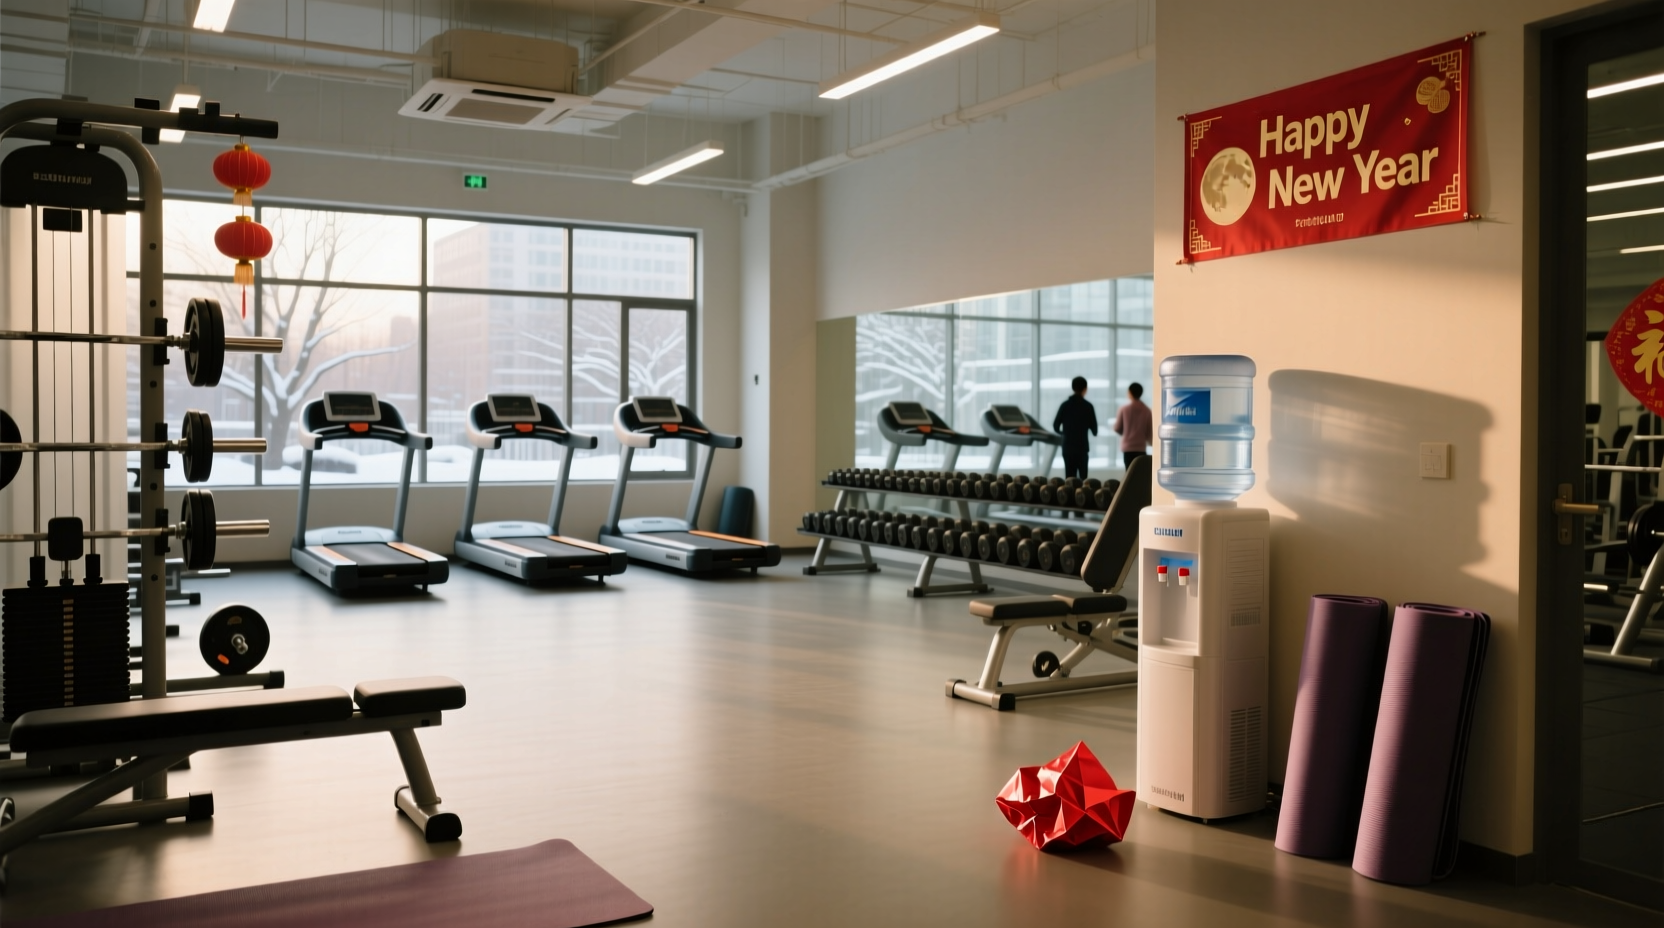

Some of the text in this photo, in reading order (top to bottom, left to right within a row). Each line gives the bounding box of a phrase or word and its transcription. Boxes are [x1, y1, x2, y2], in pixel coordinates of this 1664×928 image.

[1260, 103, 1371, 160] Happy
[1268, 147, 1439, 210] New Year
